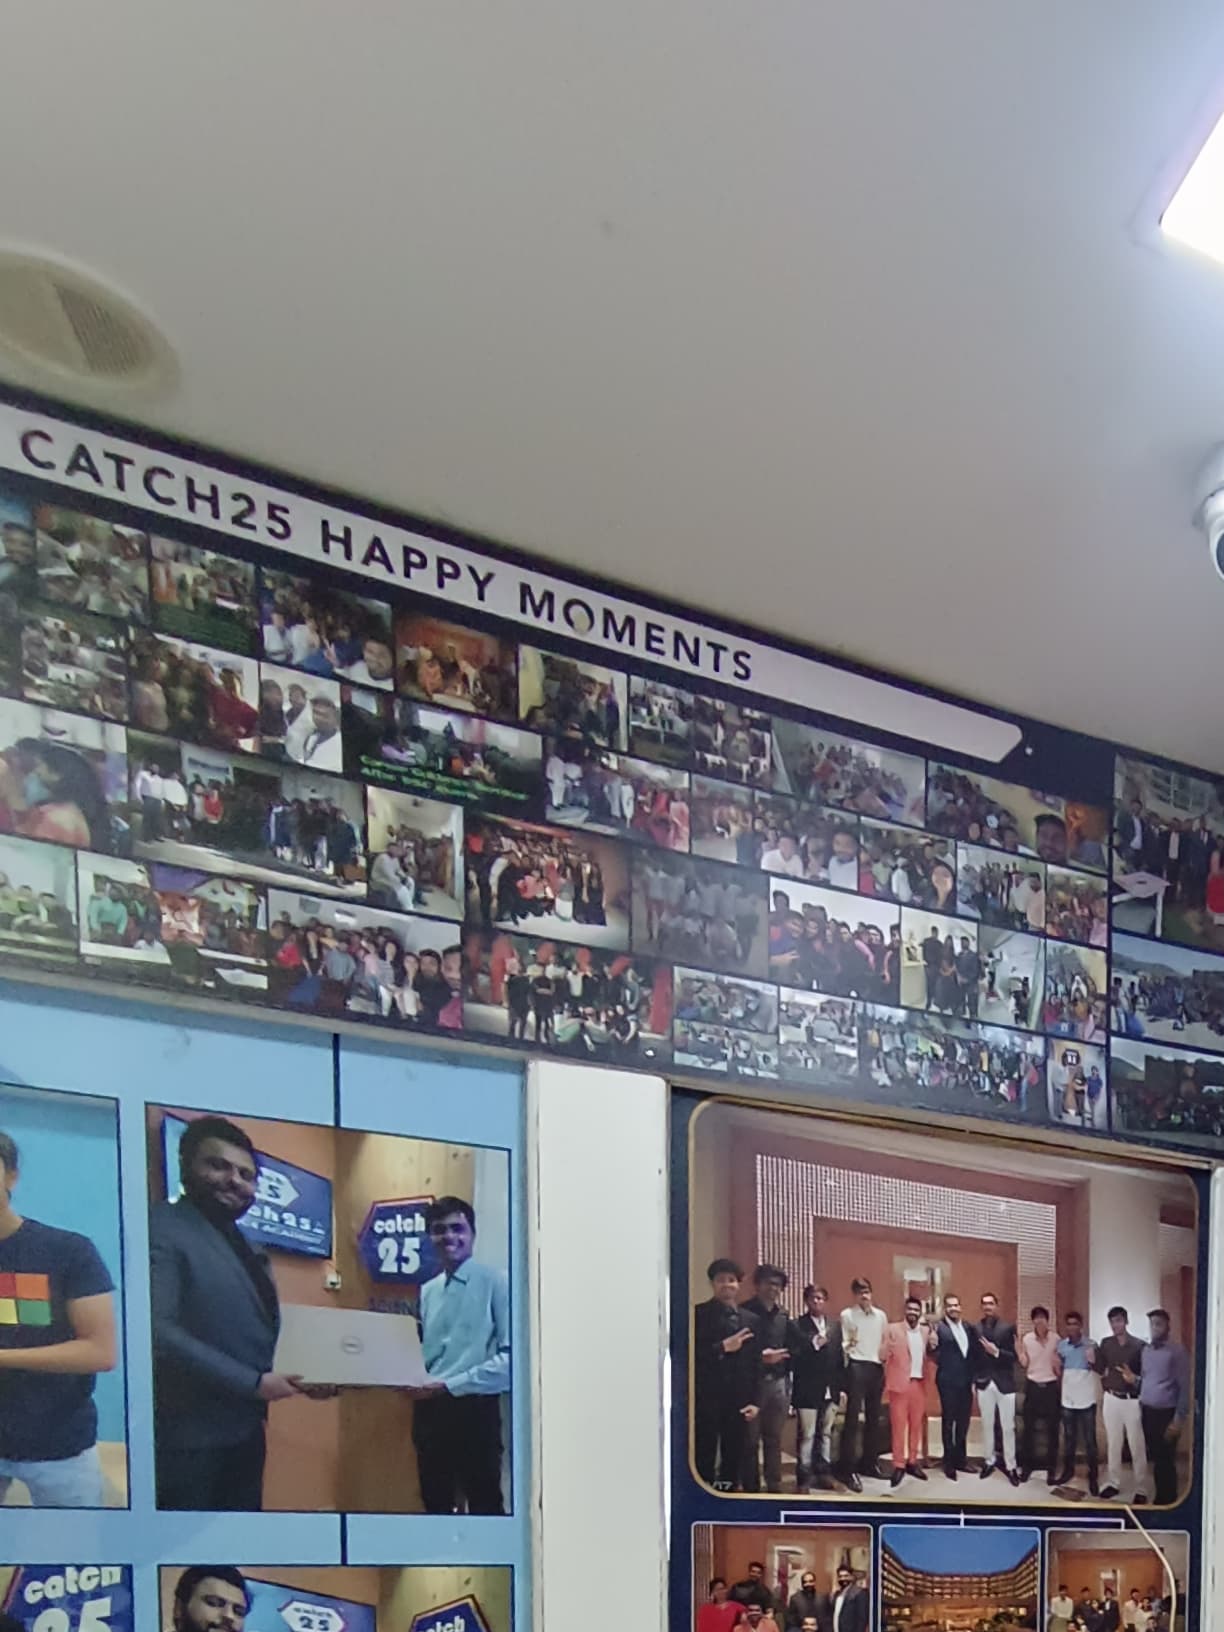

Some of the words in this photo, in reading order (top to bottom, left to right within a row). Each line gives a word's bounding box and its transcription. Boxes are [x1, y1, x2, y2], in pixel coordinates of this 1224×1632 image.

[20, 429, 293, 540] CATCH25
[320, 518, 497, 603] HAPPY
[518, 582, 752, 682] MOMENTS
[374, 1213, 426, 1235] catch
[377, 1236, 421, 1275] 25
[24, 1566, 121, 1603] catch
